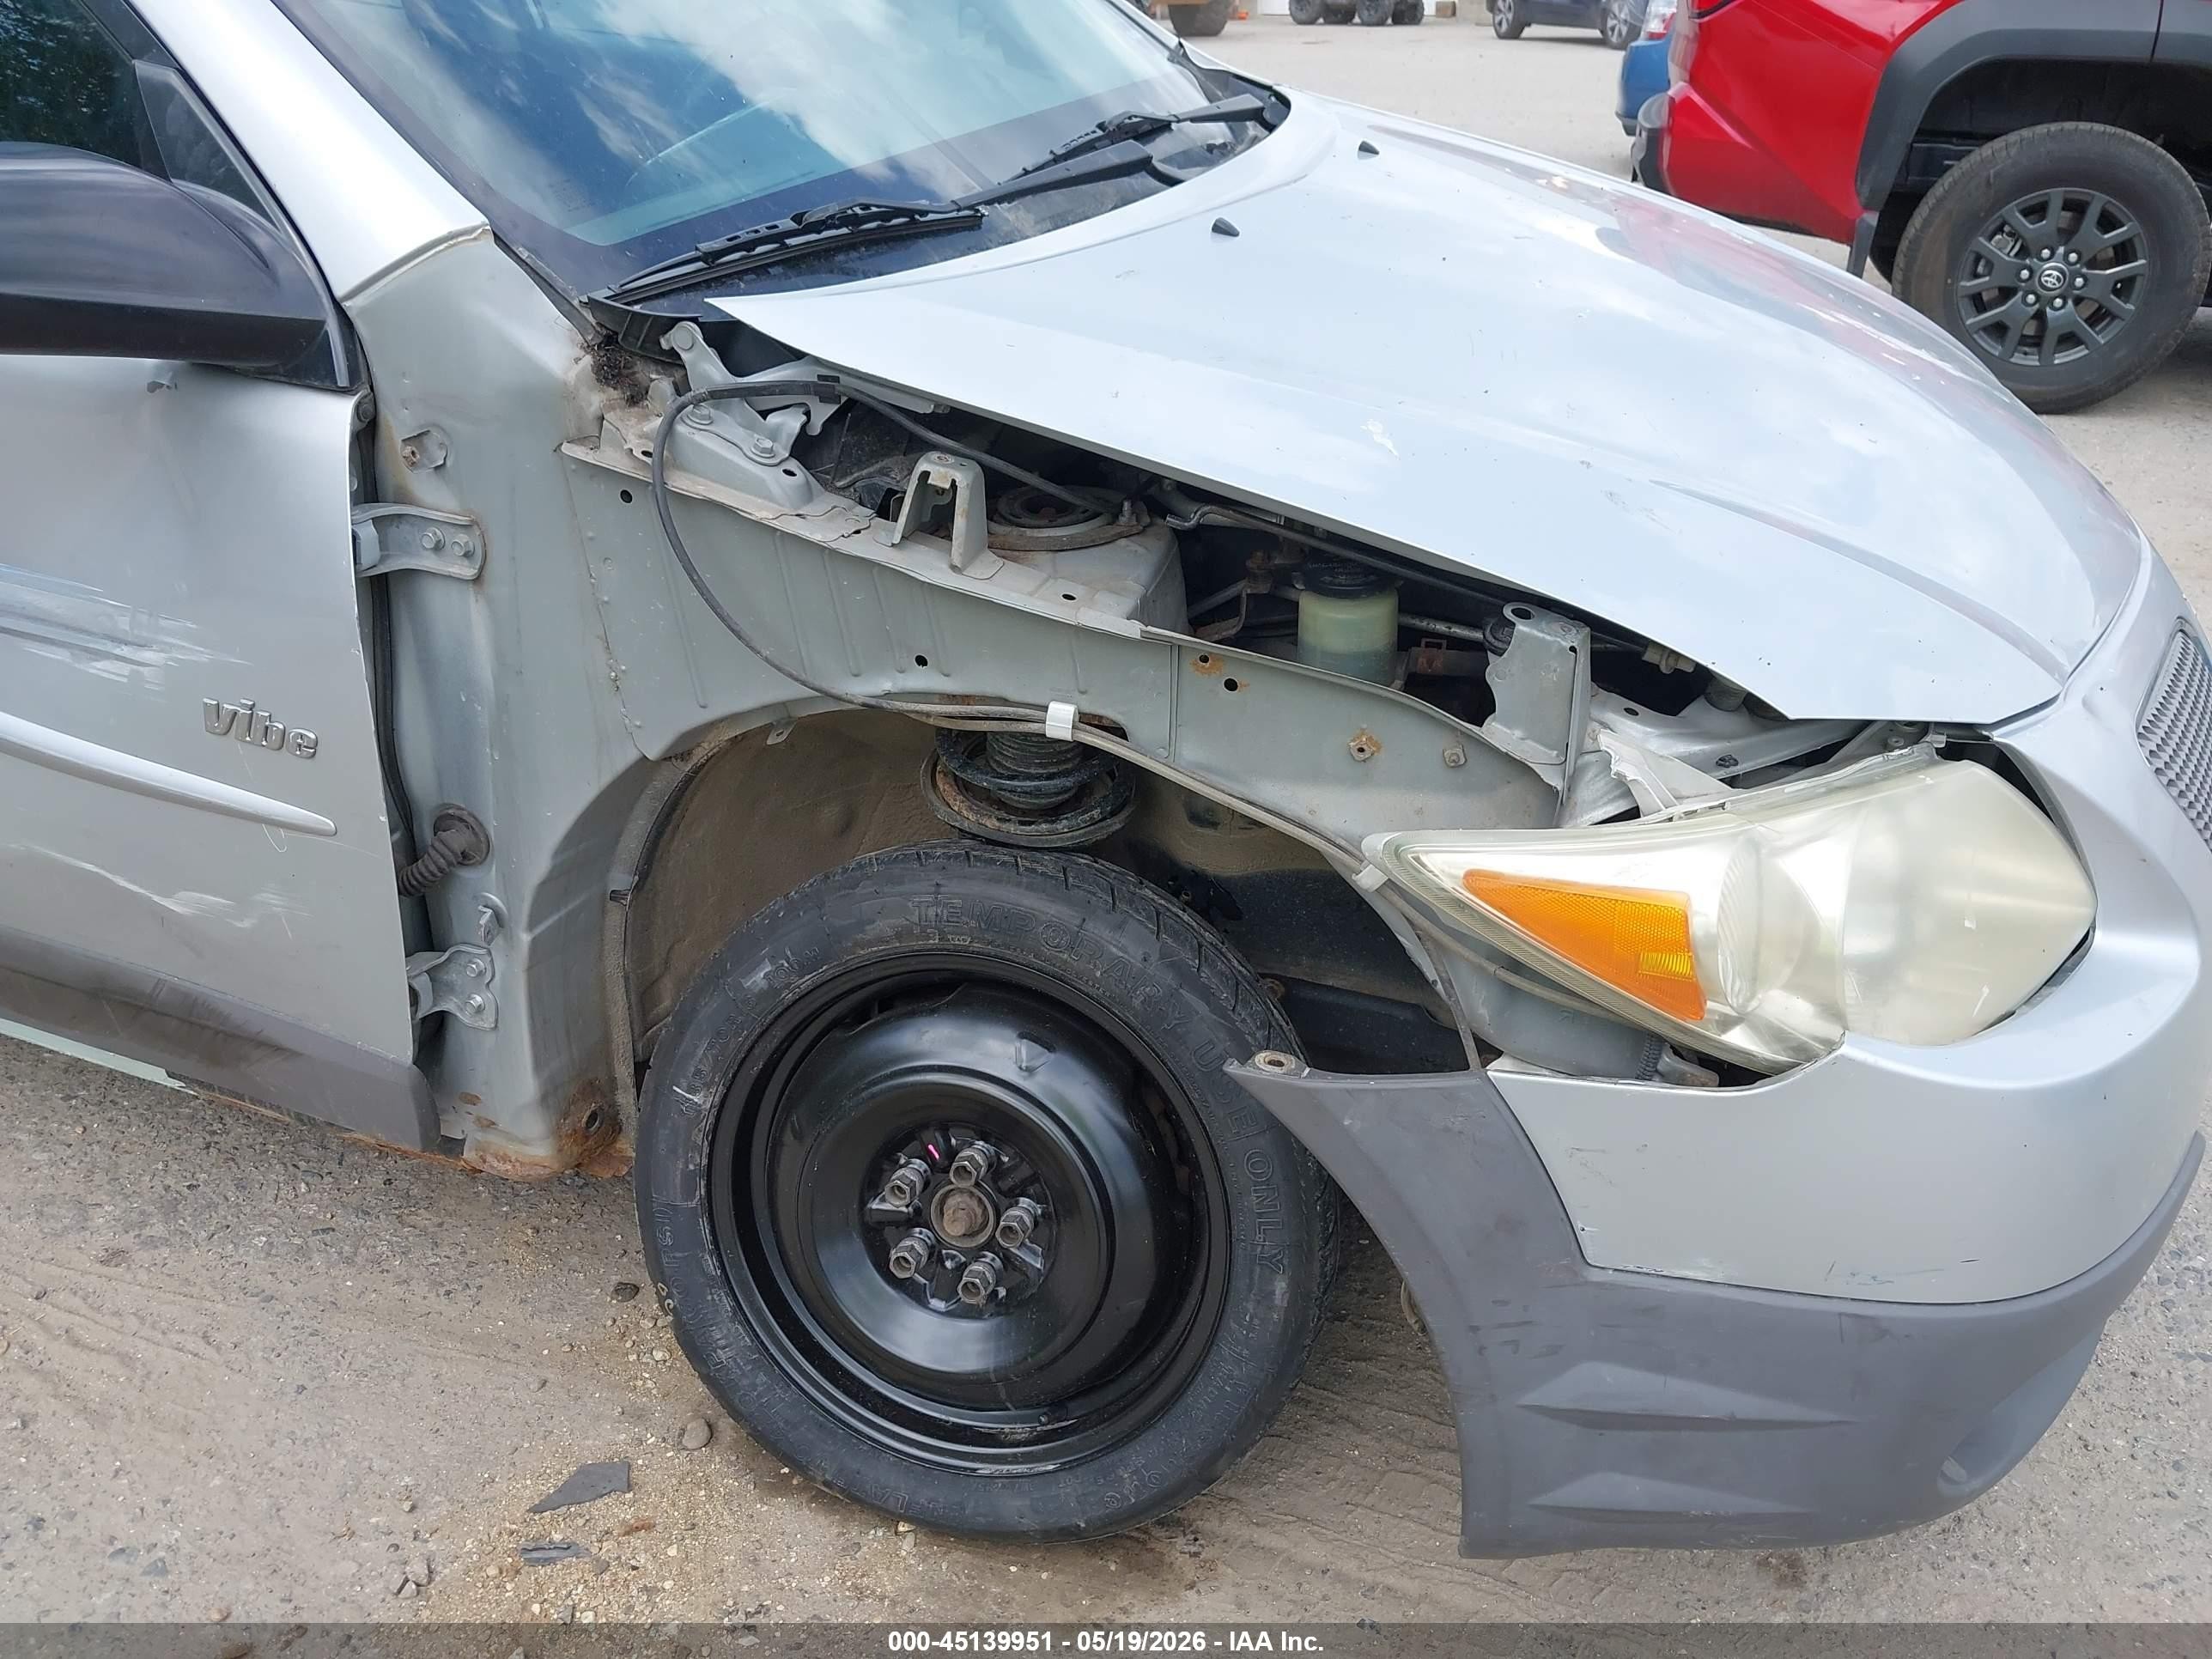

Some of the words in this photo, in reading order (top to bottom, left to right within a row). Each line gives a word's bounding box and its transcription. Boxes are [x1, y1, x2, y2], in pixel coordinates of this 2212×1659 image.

[203, 697, 318, 759] vibe
[910, 894, 1192, 1032] TEMPORARY
[1190, 1040, 1260, 1139] USE
[1244, 1148, 1284, 1274] ONLY
